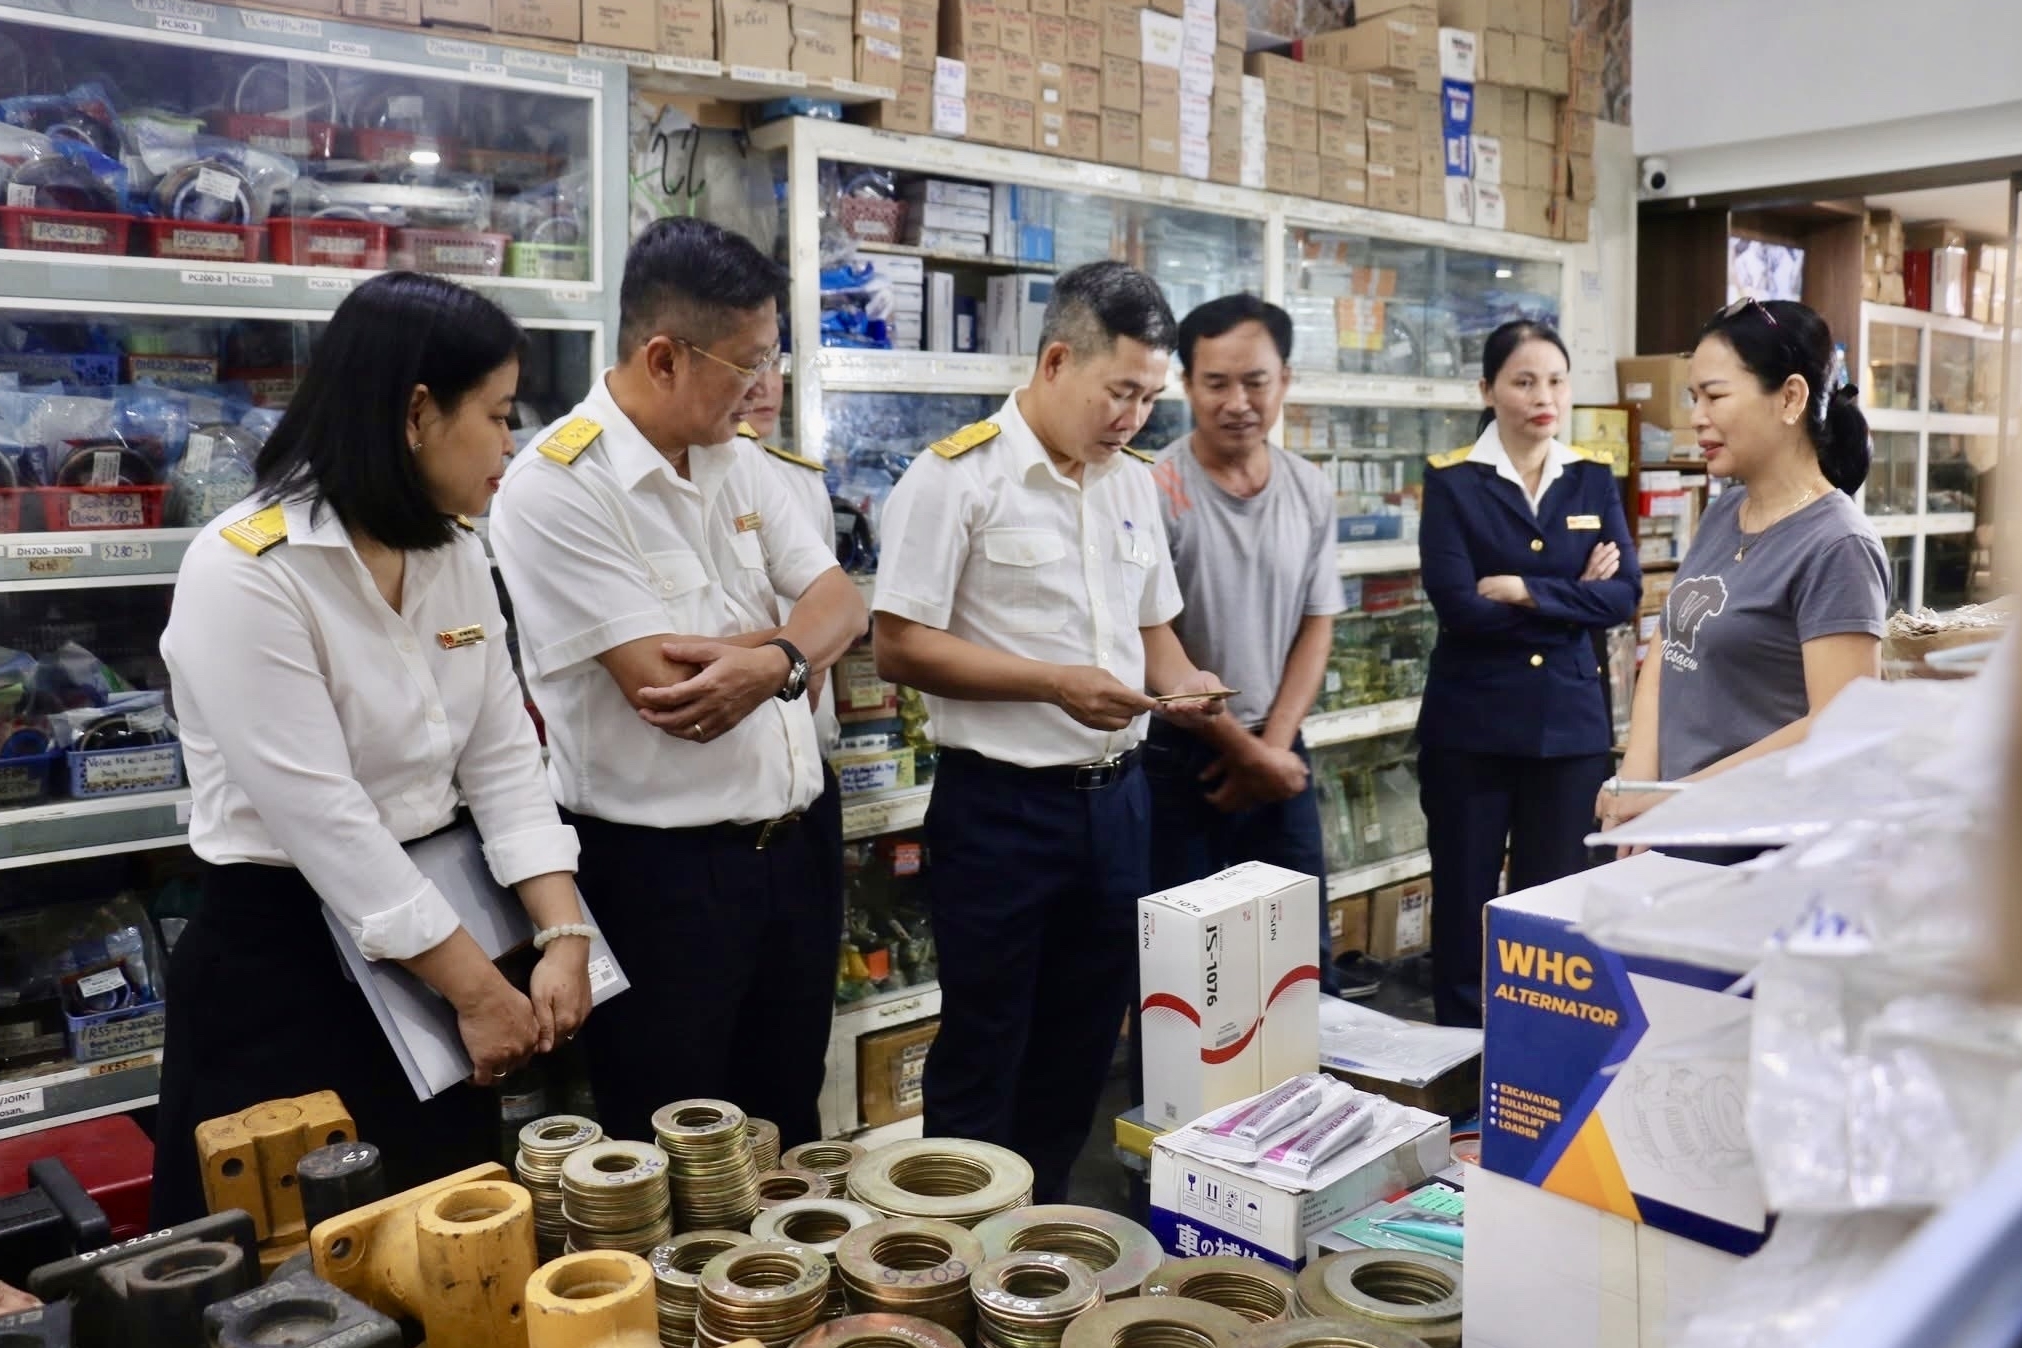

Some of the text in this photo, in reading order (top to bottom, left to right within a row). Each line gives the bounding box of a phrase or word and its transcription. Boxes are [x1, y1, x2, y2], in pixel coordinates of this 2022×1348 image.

[1206, 924, 1218, 1007] JS-1076
[1497, 939, 1594, 991] WHC
[1495, 983, 1618, 1027] ALTERNATOR
[1499, 1096, 1562, 1122] BULLDOZERS
[1500, 1083, 1560, 1109] EXCAVATOR
[1498, 1119, 1539, 1140] LOADER
[1499, 1107, 1546, 1129] FORKLIFT
